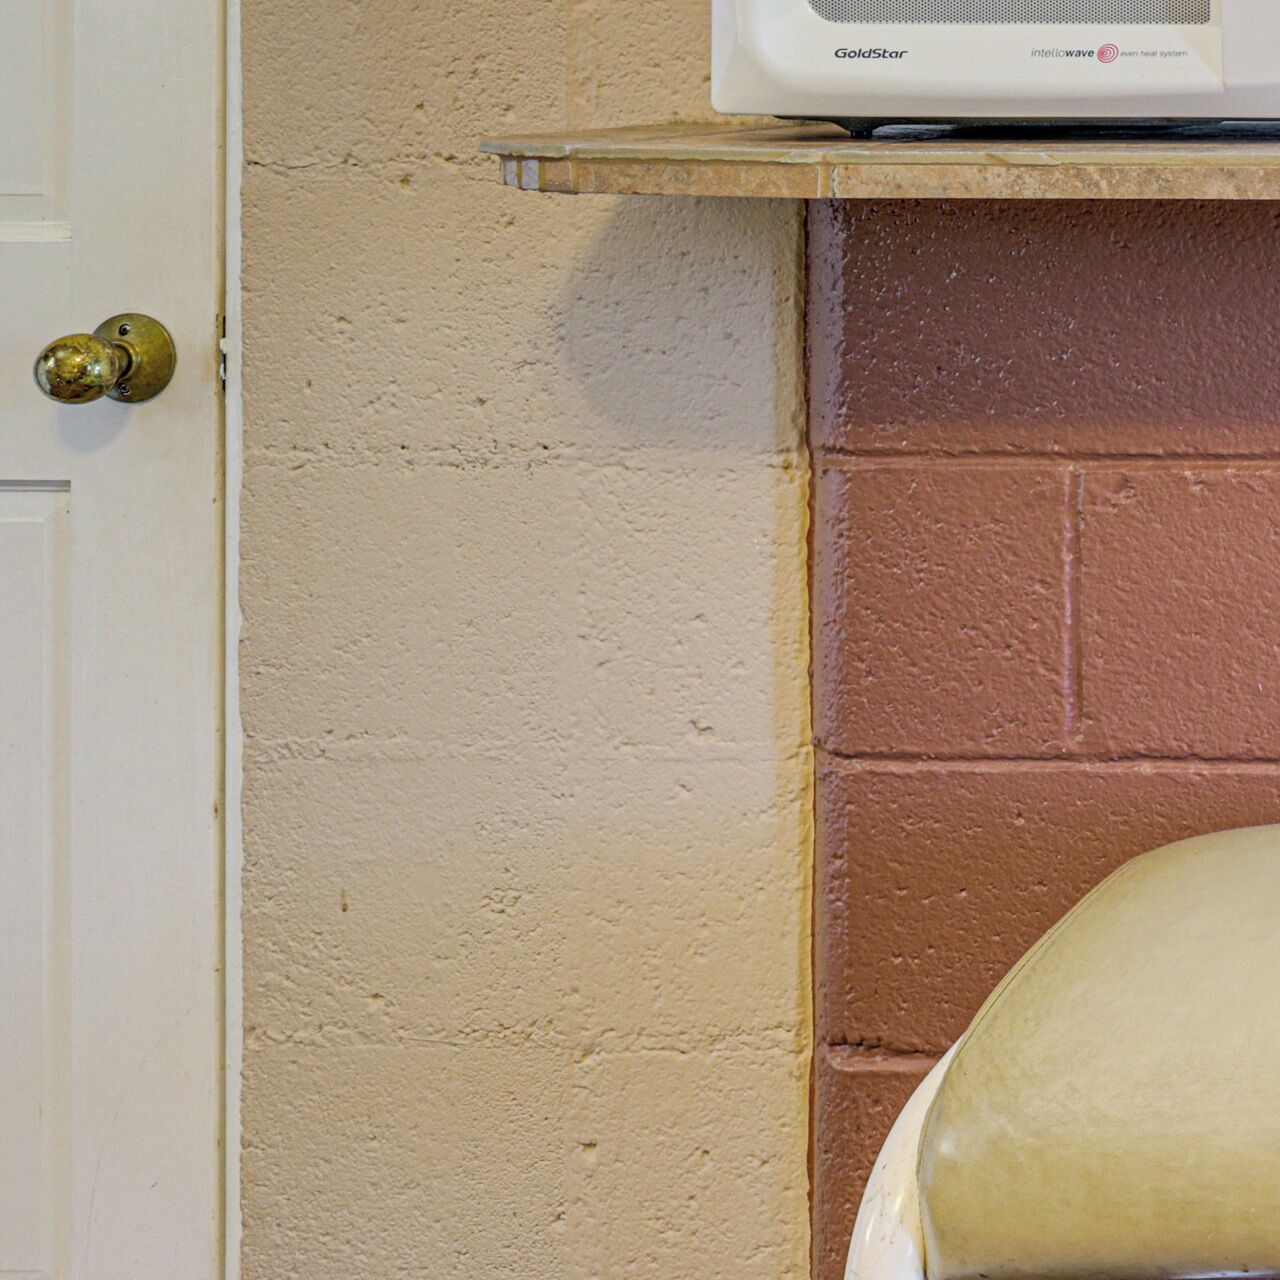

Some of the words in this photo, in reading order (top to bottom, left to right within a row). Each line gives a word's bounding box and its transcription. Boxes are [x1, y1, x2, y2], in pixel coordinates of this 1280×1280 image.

[834, 47, 908, 60] GoldStar
[1031, 48, 1094, 58] intellowave
[1160, 50, 1187, 58] system
